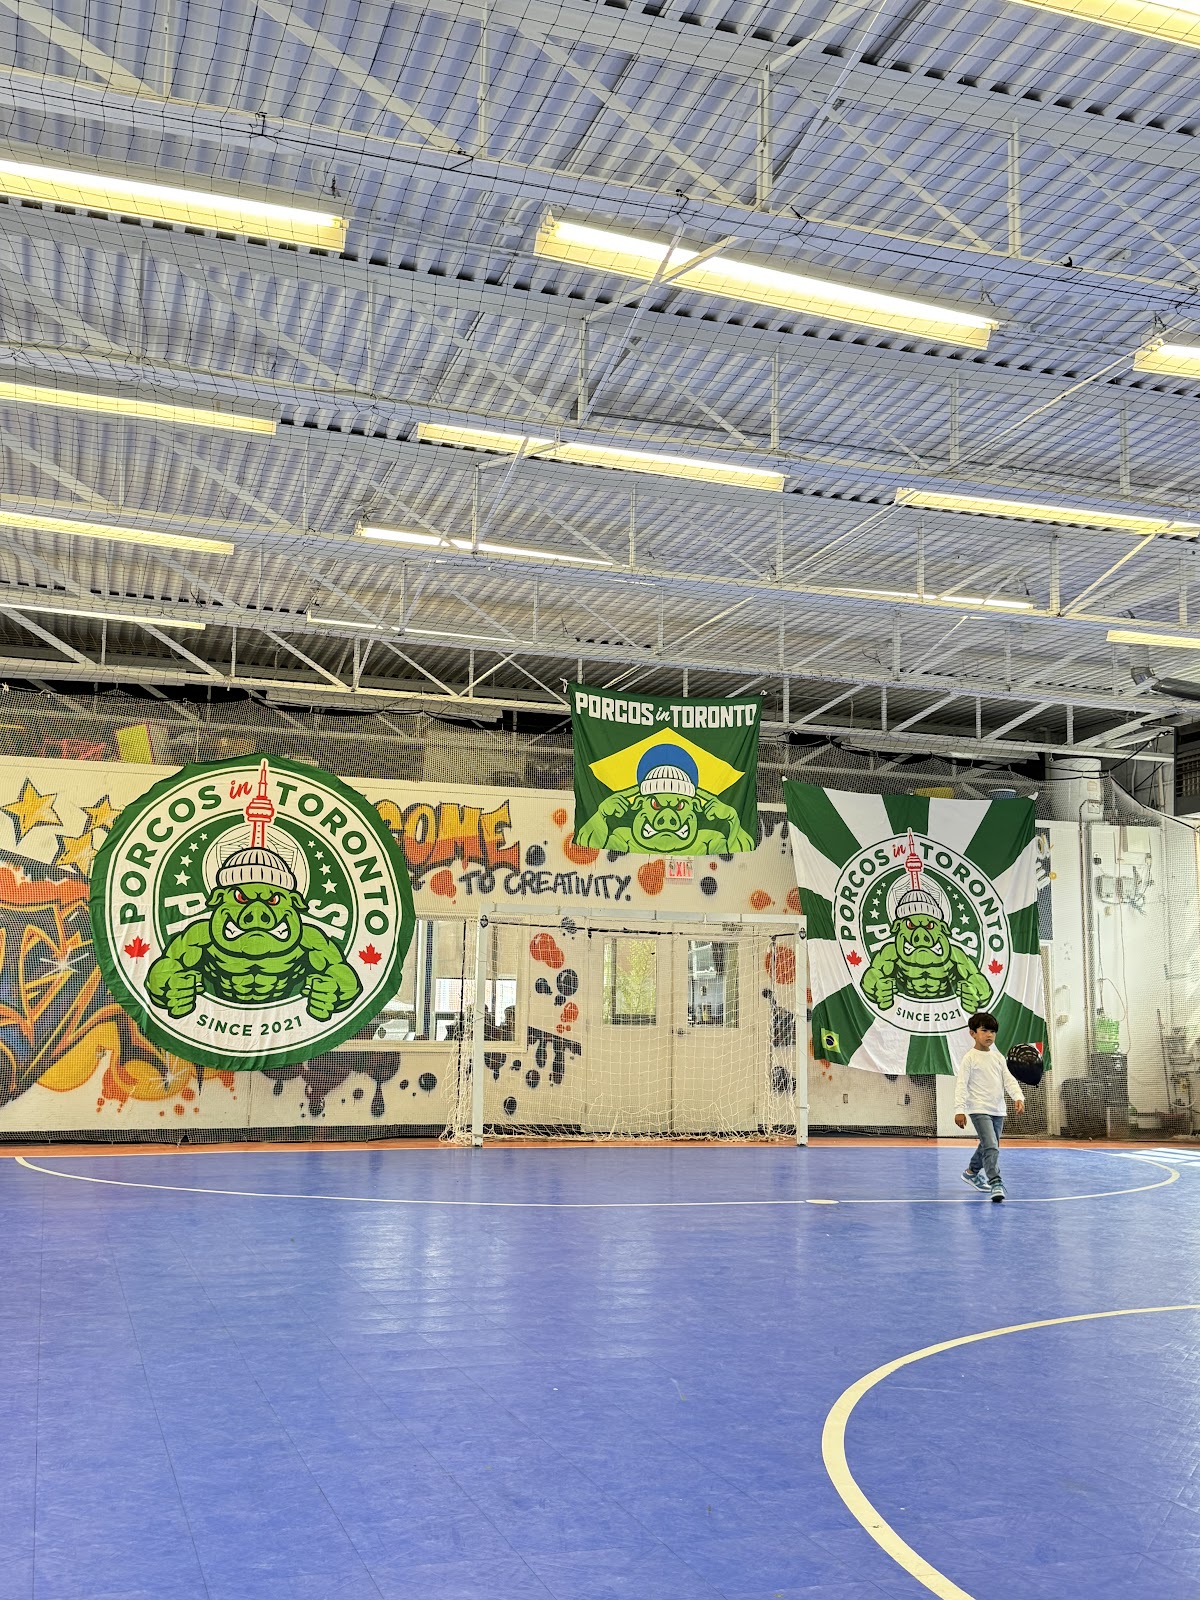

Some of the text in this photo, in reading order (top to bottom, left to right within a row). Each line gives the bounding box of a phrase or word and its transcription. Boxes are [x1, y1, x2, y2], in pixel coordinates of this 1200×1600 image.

[575, 691, 757, 729] PORCOS in TORONTO
[119, 779, 390, 937] PORCOS in TORONTO
[668, 861, 693, 878] EXIT
[458, 868, 632, 902] TO CREATIVITY.
[840, 841, 1005, 954] PORCOS in TORONTO
[196, 1013, 303, 1037] SINCE 2021
[895, 1006, 962, 1023] SINCE 2021
